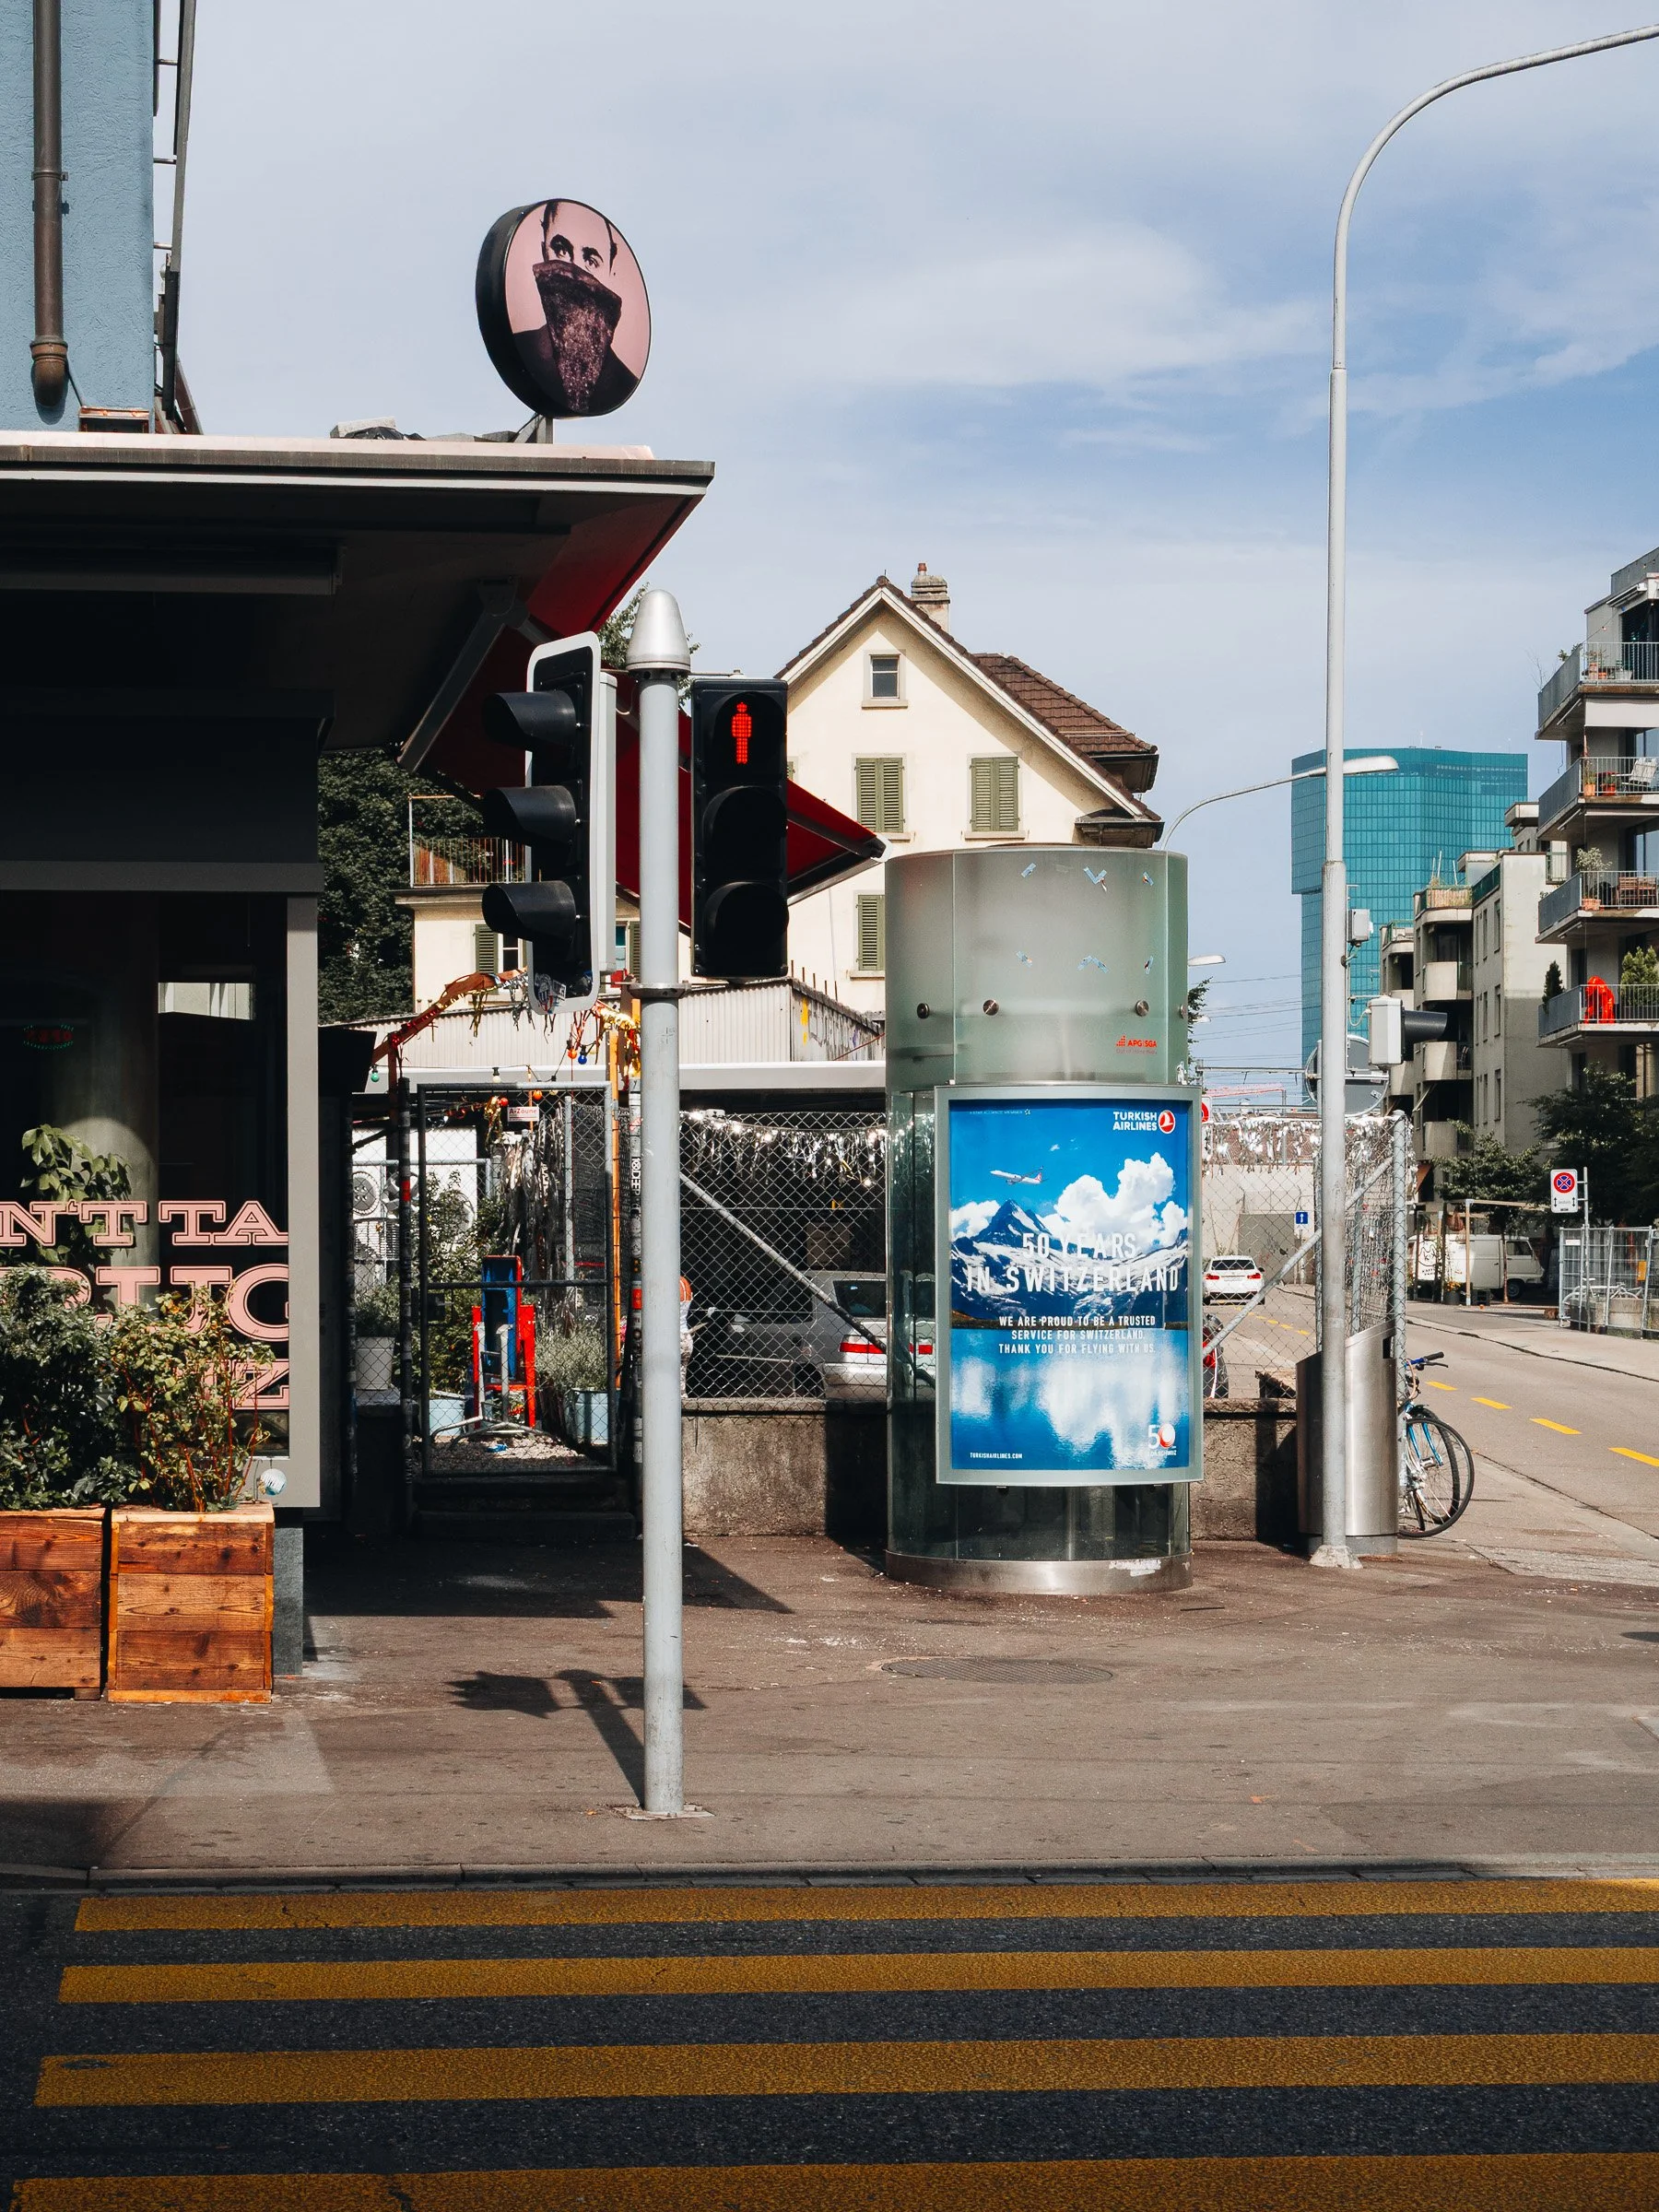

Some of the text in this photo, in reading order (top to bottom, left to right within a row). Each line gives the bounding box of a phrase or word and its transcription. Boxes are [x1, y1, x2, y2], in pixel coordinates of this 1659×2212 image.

[1112, 1112, 1158, 1121] TURKISH
[1112, 1122, 1158, 1131] AIRLINES
[1022, 1233, 1136, 1259] 50 YEARS
[968, 1266, 1179, 1291] IN SWITZERLAND
[999, 1316, 1156, 1326] WE ARE PROUD TO BE A TRUSTED
[1011, 1330, 1053, 1340] SERVICE
[1057, 1330, 1076, 1340] FOR
[999, 1344, 1031, 1354] THANK
[1035, 1344, 1053, 1354] YOU
[1059, 1344, 1077, 1354] FOR
[1081, 1344, 1113, 1354] FLYING
[1118, 1344, 1140, 1354] WITH
